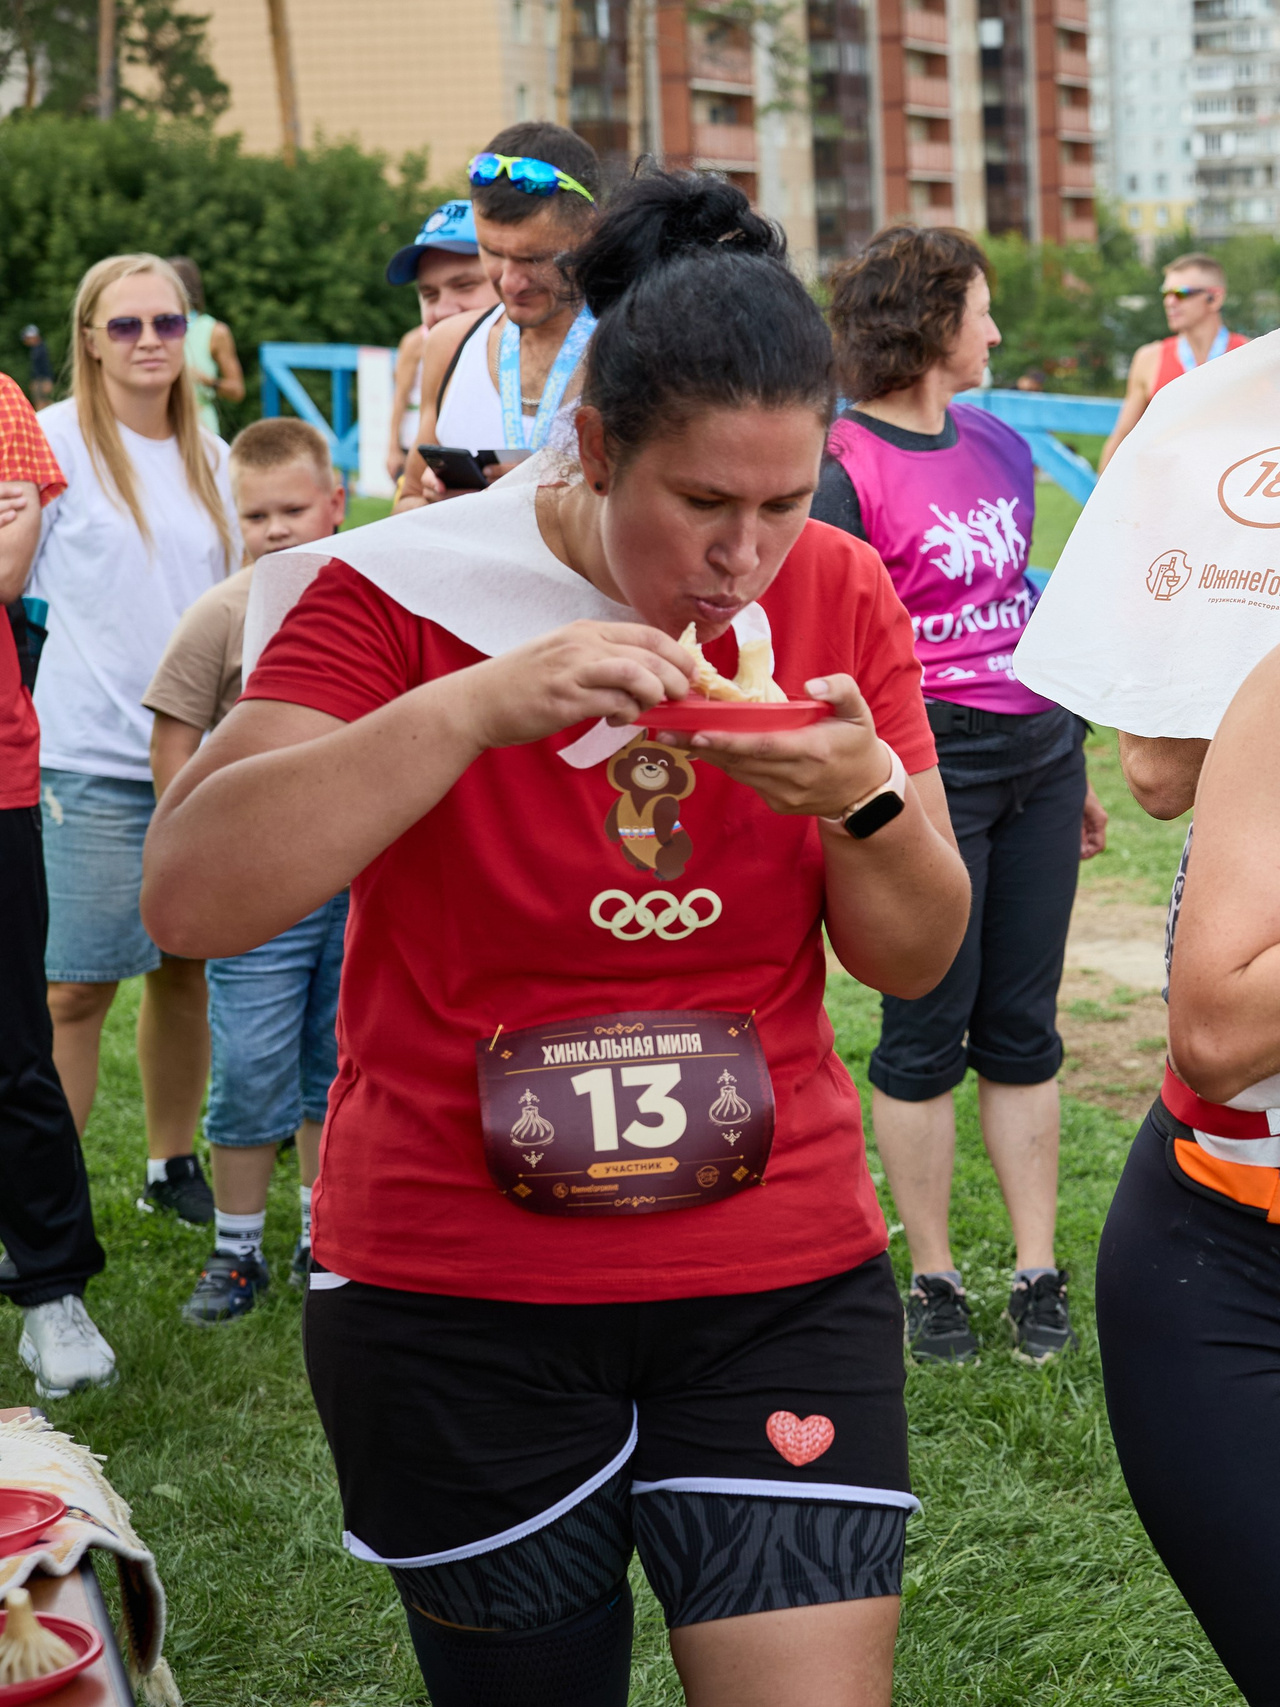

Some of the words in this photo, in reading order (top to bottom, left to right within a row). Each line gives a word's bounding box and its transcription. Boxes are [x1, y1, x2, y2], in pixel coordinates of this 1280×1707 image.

[1207, 597, 1247, 605] грузинский
[541, 1036, 653, 1065] ХИНКАЛЬНАЯ
[655, 1033, 703, 1055] МИЛЯ
[570, 1063, 688, 1152] 13
[604, 1160, 664, 1175] УЧАСТНИК
